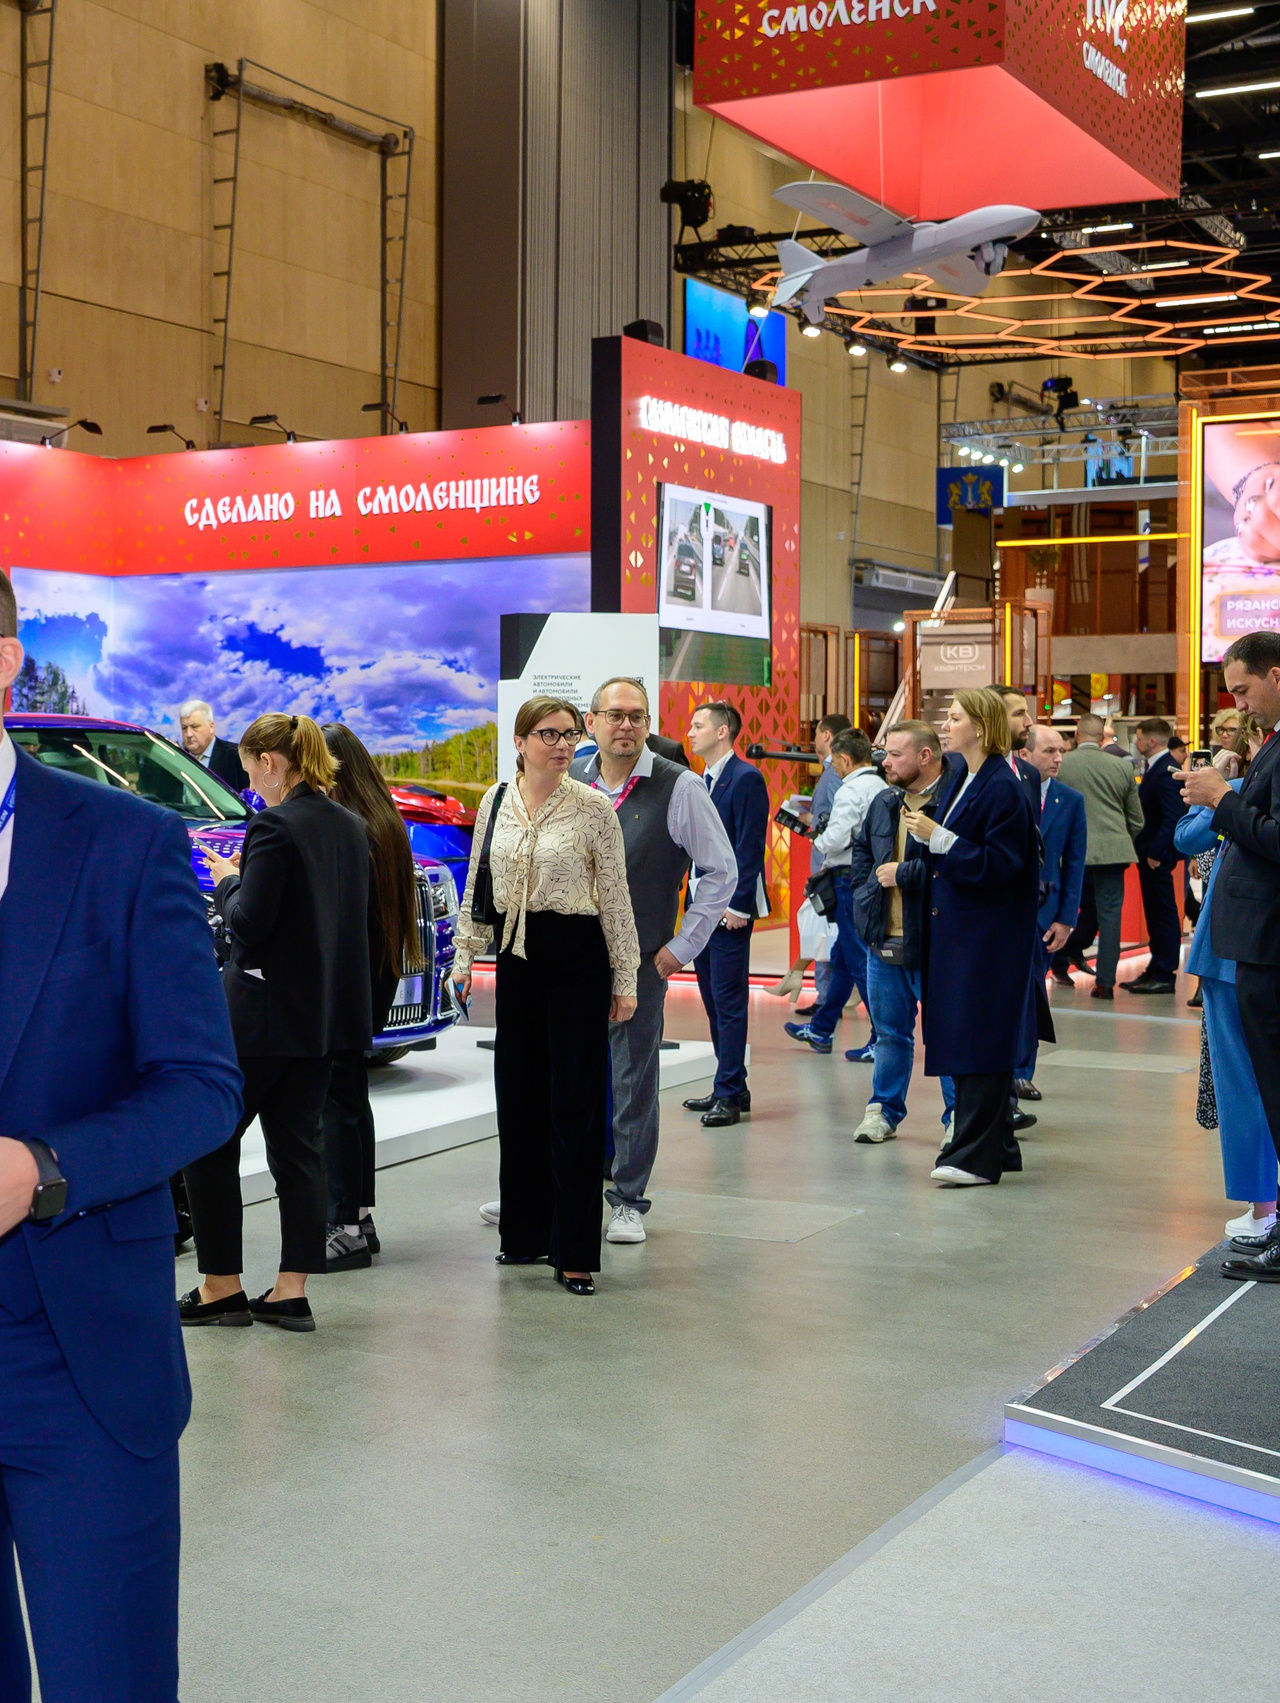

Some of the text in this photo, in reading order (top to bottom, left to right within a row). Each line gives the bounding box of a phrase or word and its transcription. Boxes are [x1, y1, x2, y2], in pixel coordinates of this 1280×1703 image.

[184, 474, 541, 531] СДЕЛАНО НА СМОЛЕНЩИНЕ
